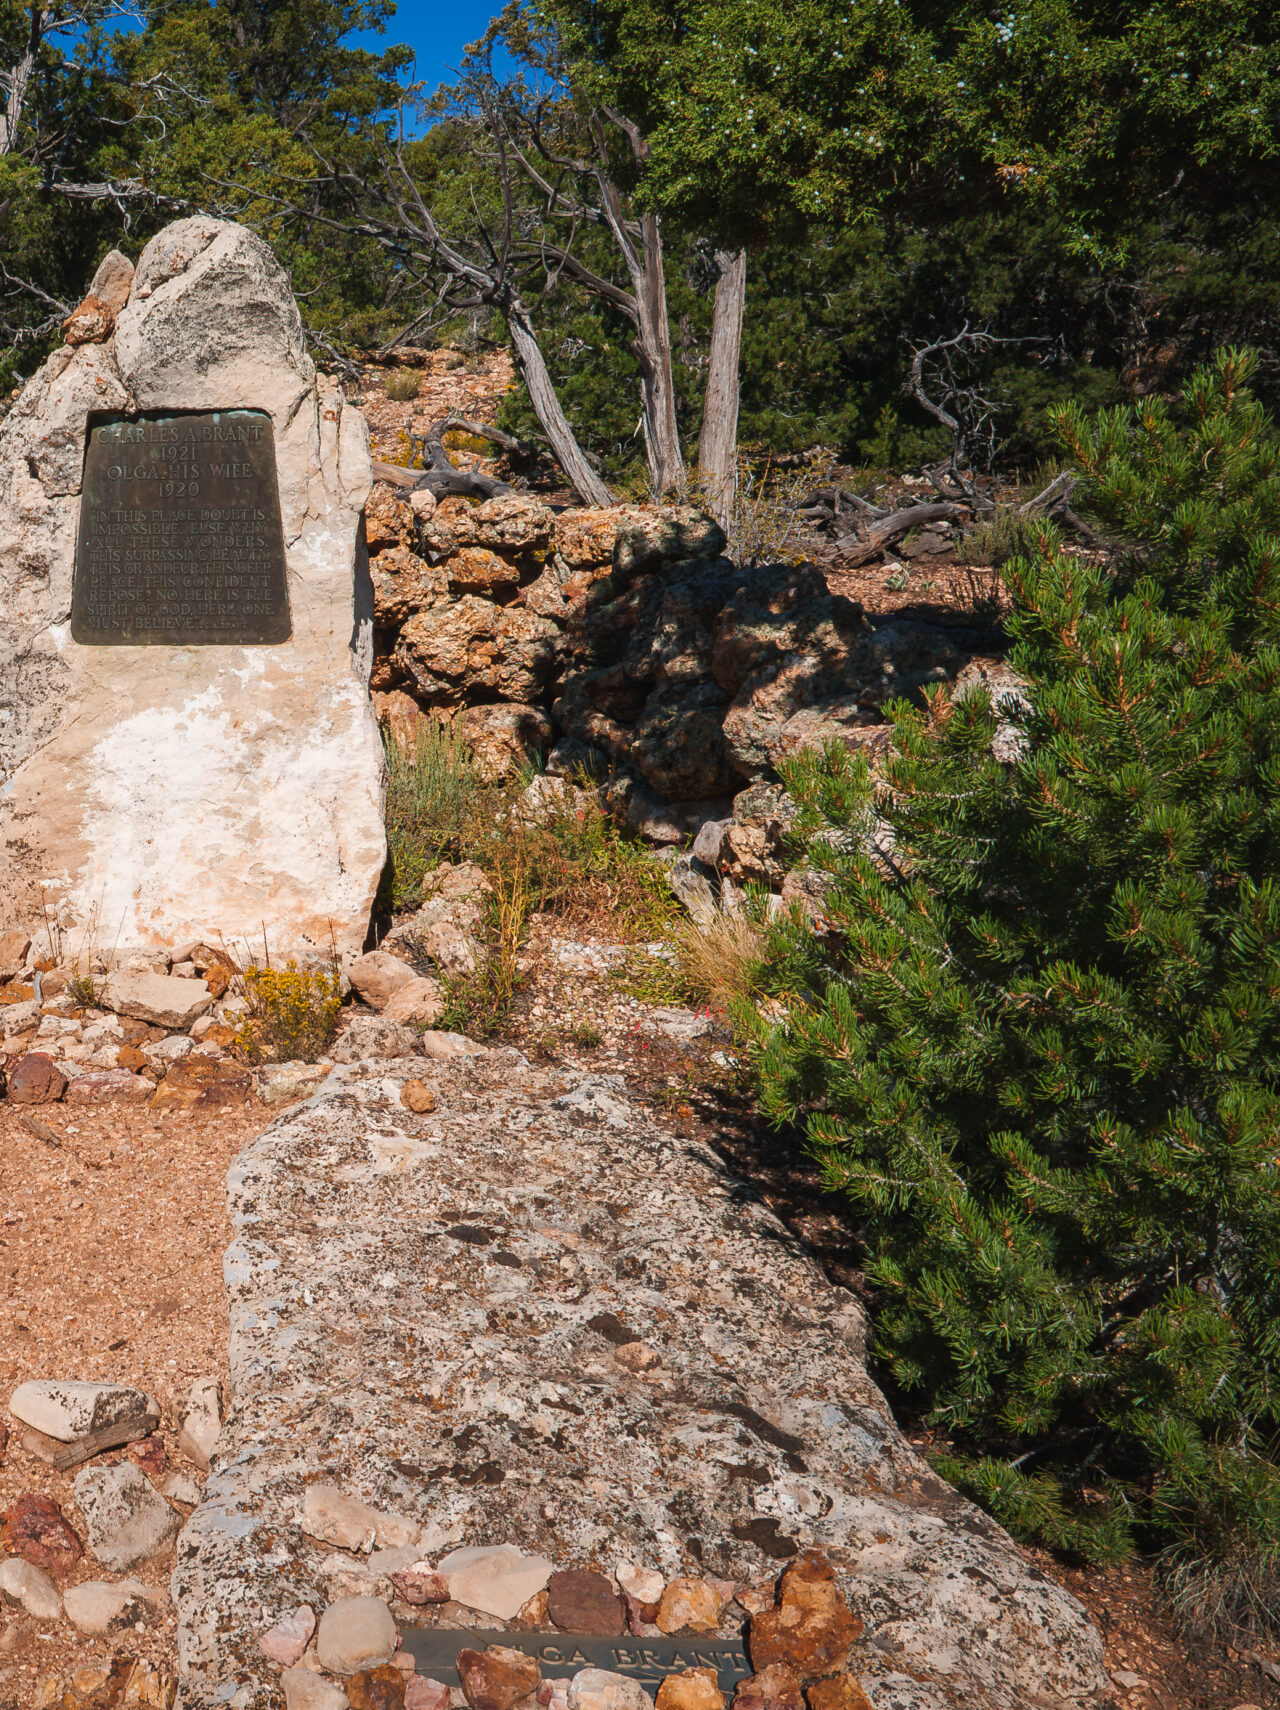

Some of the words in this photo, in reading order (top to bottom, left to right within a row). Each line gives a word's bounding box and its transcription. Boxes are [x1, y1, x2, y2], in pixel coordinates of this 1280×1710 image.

[96, 427, 179, 444] CHARLES
[183, 426, 200, 442] A.
[202, 425, 263, 441] BRANT
[160, 446, 196, 463] 1921
[169, 464, 200, 479] HIS
[208, 463, 253, 479] WIFE
[159, 481, 199, 497] 1920
[114, 510, 147, 522] THIS
[152, 510, 196, 522] PLACE
[200, 509, 250, 521] DOUBT
[253, 509, 265, 521] IS
[231, 522, 267, 534] WHY
[95, 536, 125, 548] ALL
[130, 536, 181, 548] THESE
[90, 550, 121, 562] THIS
[125, 549, 209, 562] SURPASSING
[89, 563, 121, 575] THIS
[204, 562, 234, 574] THIS
[237, 562, 272, 574] DEEP
[144, 576, 177, 588] THIS
[183, 575, 271, 588] CONFIDENT
[89, 590, 152, 601] REPOSE?
[185, 589, 223, 601] HERE
[227, 589, 240, 601] IS
[243, 589, 274, 601] THE
[87, 604, 130, 616] SPIRIT
[136, 603, 155, 615] OF
[198, 603, 237, 615] HERE
[242, 603, 275, 615] ONE
[87, 617, 129, 629] MUST
[610, 1647, 746, 1672] BRANT
